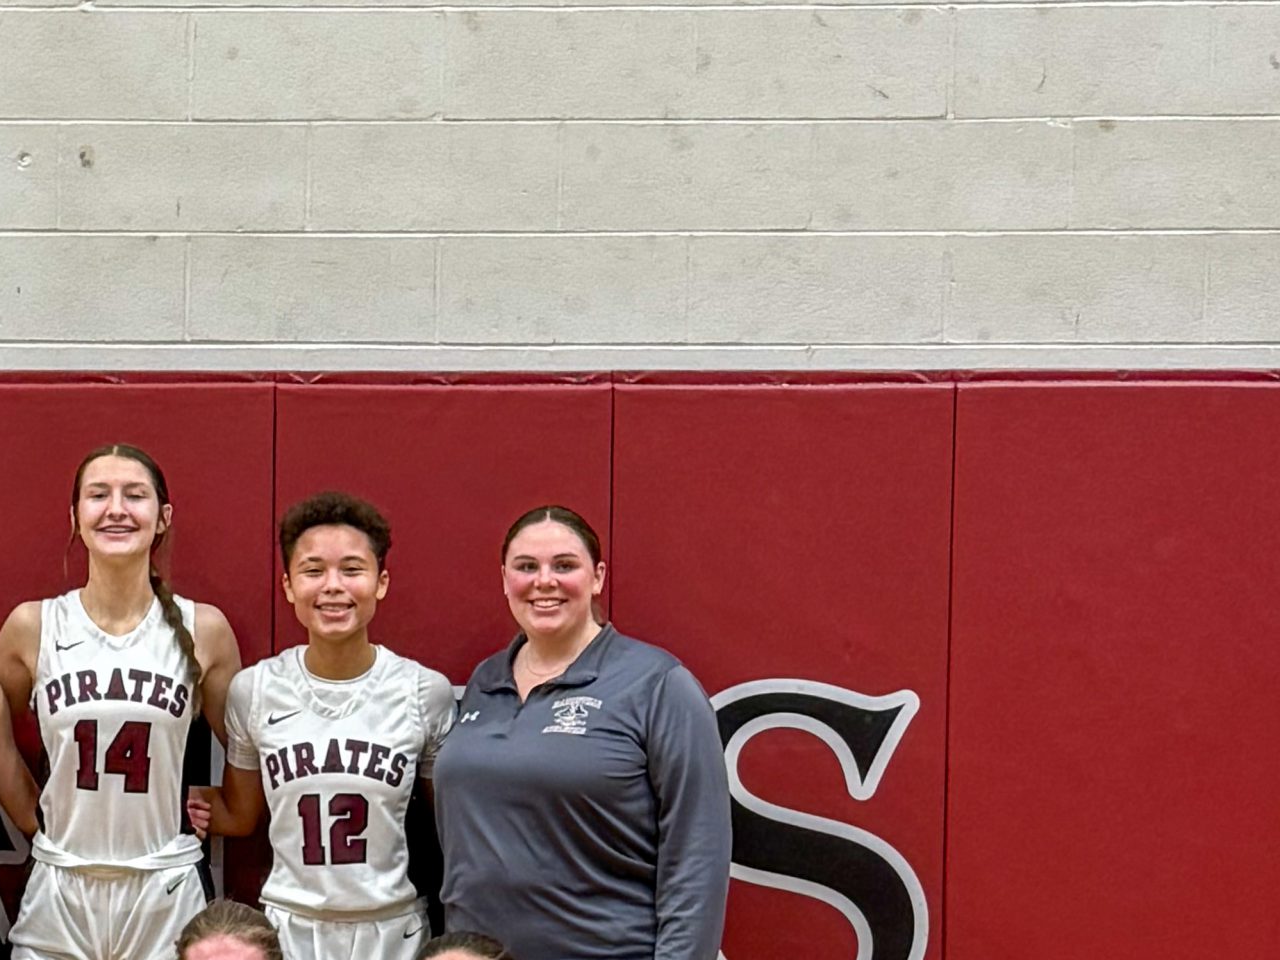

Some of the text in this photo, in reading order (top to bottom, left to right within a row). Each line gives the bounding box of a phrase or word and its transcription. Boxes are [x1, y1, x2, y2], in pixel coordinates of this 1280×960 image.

[45, 667, 189, 718] PIRATES
[74, 719, 152, 794] 14
[265, 738, 408, 790] PIRATES
[297, 793, 369, 866] 12
